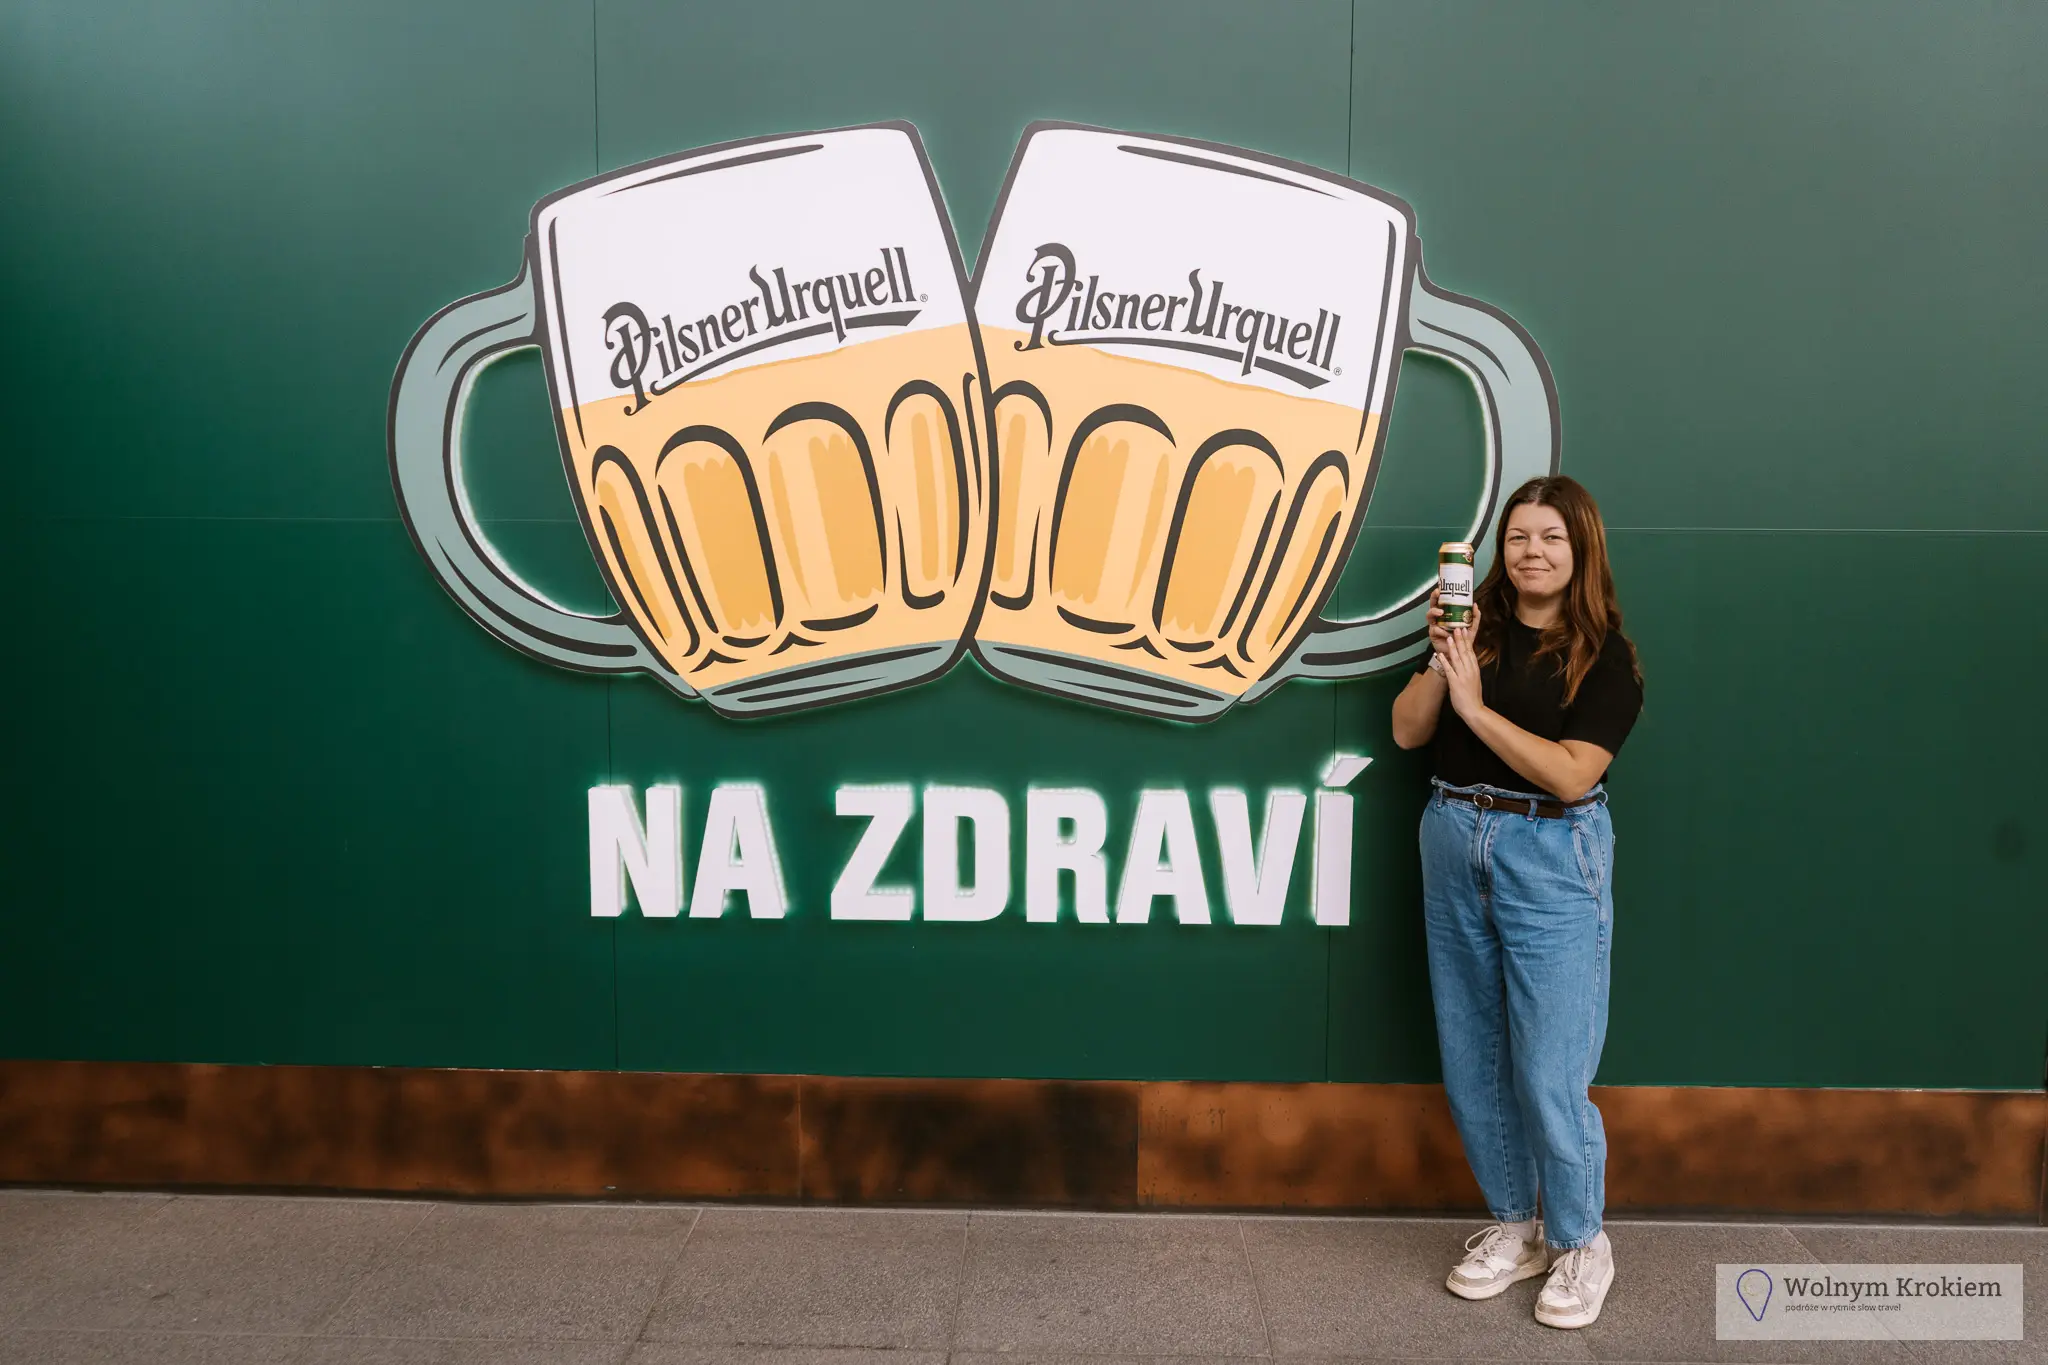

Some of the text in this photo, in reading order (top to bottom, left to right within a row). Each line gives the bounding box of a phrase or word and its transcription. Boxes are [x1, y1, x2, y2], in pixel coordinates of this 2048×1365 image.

[601, 247, 918, 416] Pilsner Urquell
[1013, 242, 1341, 377] Pilsner Urquell
[1440, 578, 1470, 597] Urquell
[587, 756, 1374, 926] NA ZDRAVÍ
